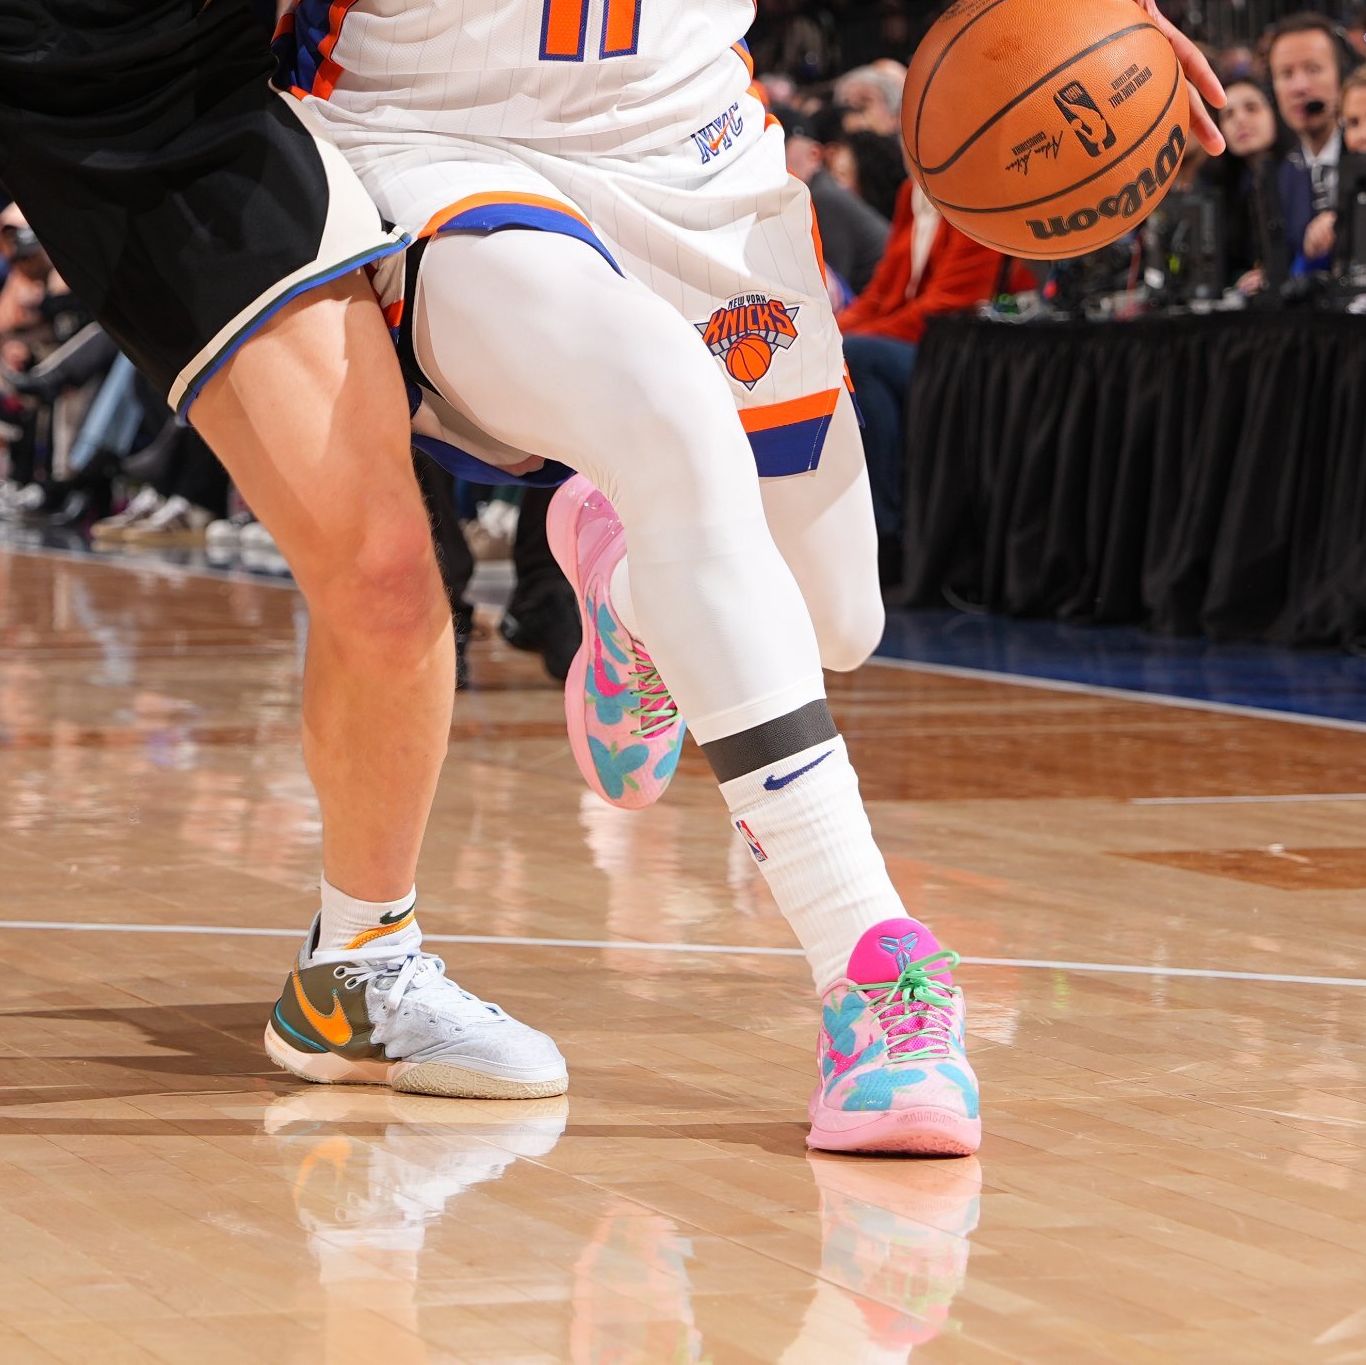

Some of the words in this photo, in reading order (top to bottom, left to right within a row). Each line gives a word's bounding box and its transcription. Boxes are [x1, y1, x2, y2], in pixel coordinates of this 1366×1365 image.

[1108, 91, 1124, 108] BALL
[690, 101, 743, 165] NYC
[1025, 124, 1186, 240] Wilson
[702, 299, 798, 345] KNICKS
[728, 296, 745, 309] NEW
[746, 294, 767, 304] YORK
